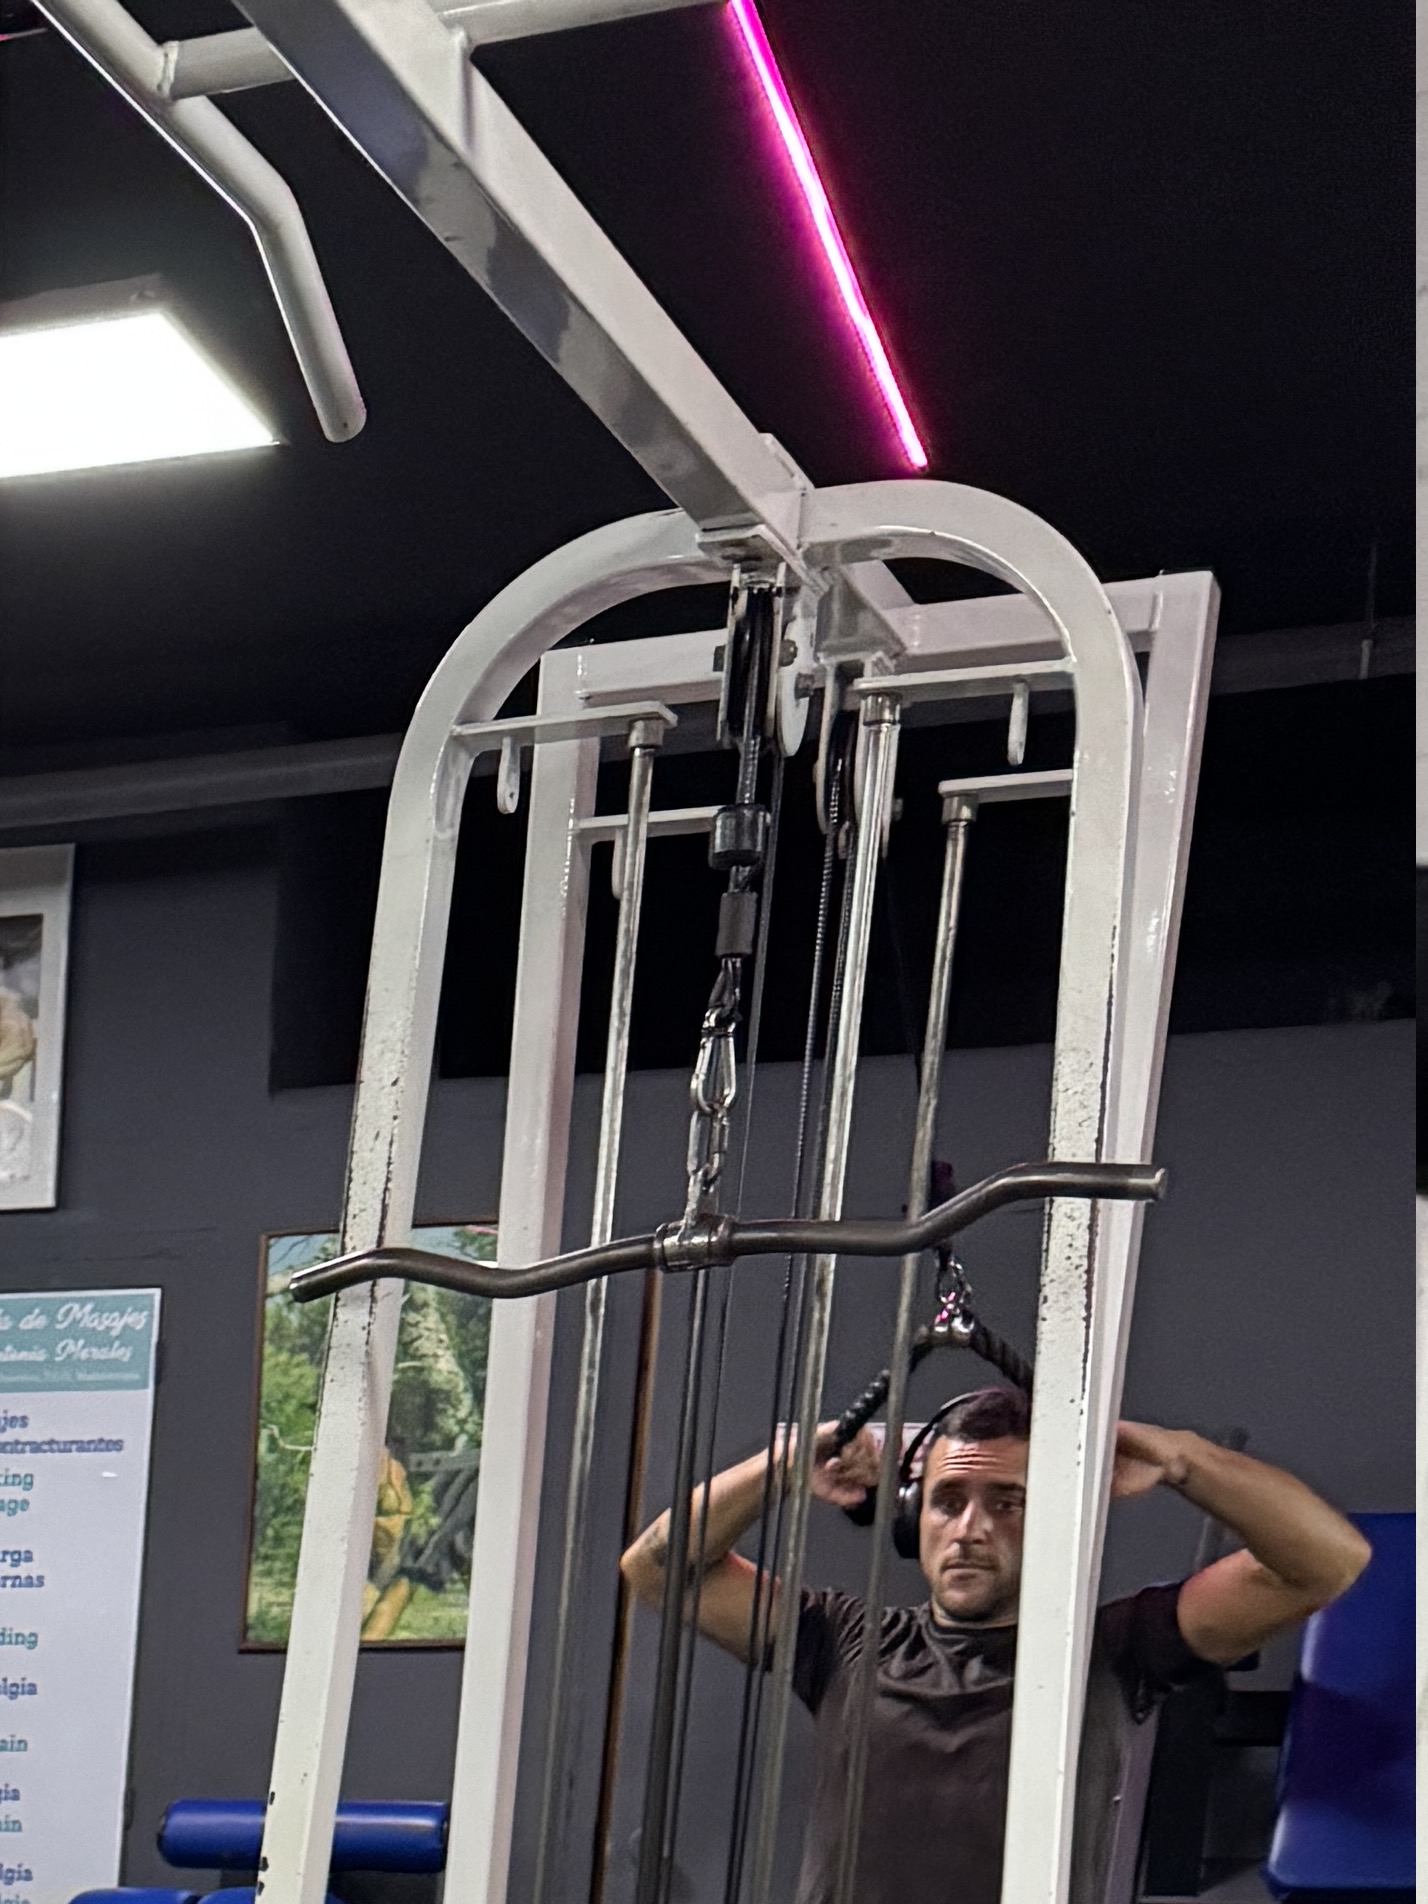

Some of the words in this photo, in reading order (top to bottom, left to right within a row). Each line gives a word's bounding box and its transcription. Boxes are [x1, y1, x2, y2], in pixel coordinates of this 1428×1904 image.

[19, 1308, 48, 1330] de
[55, 1302, 149, 1337] Masajes
[54, 1338, 133, 1362] Morales
